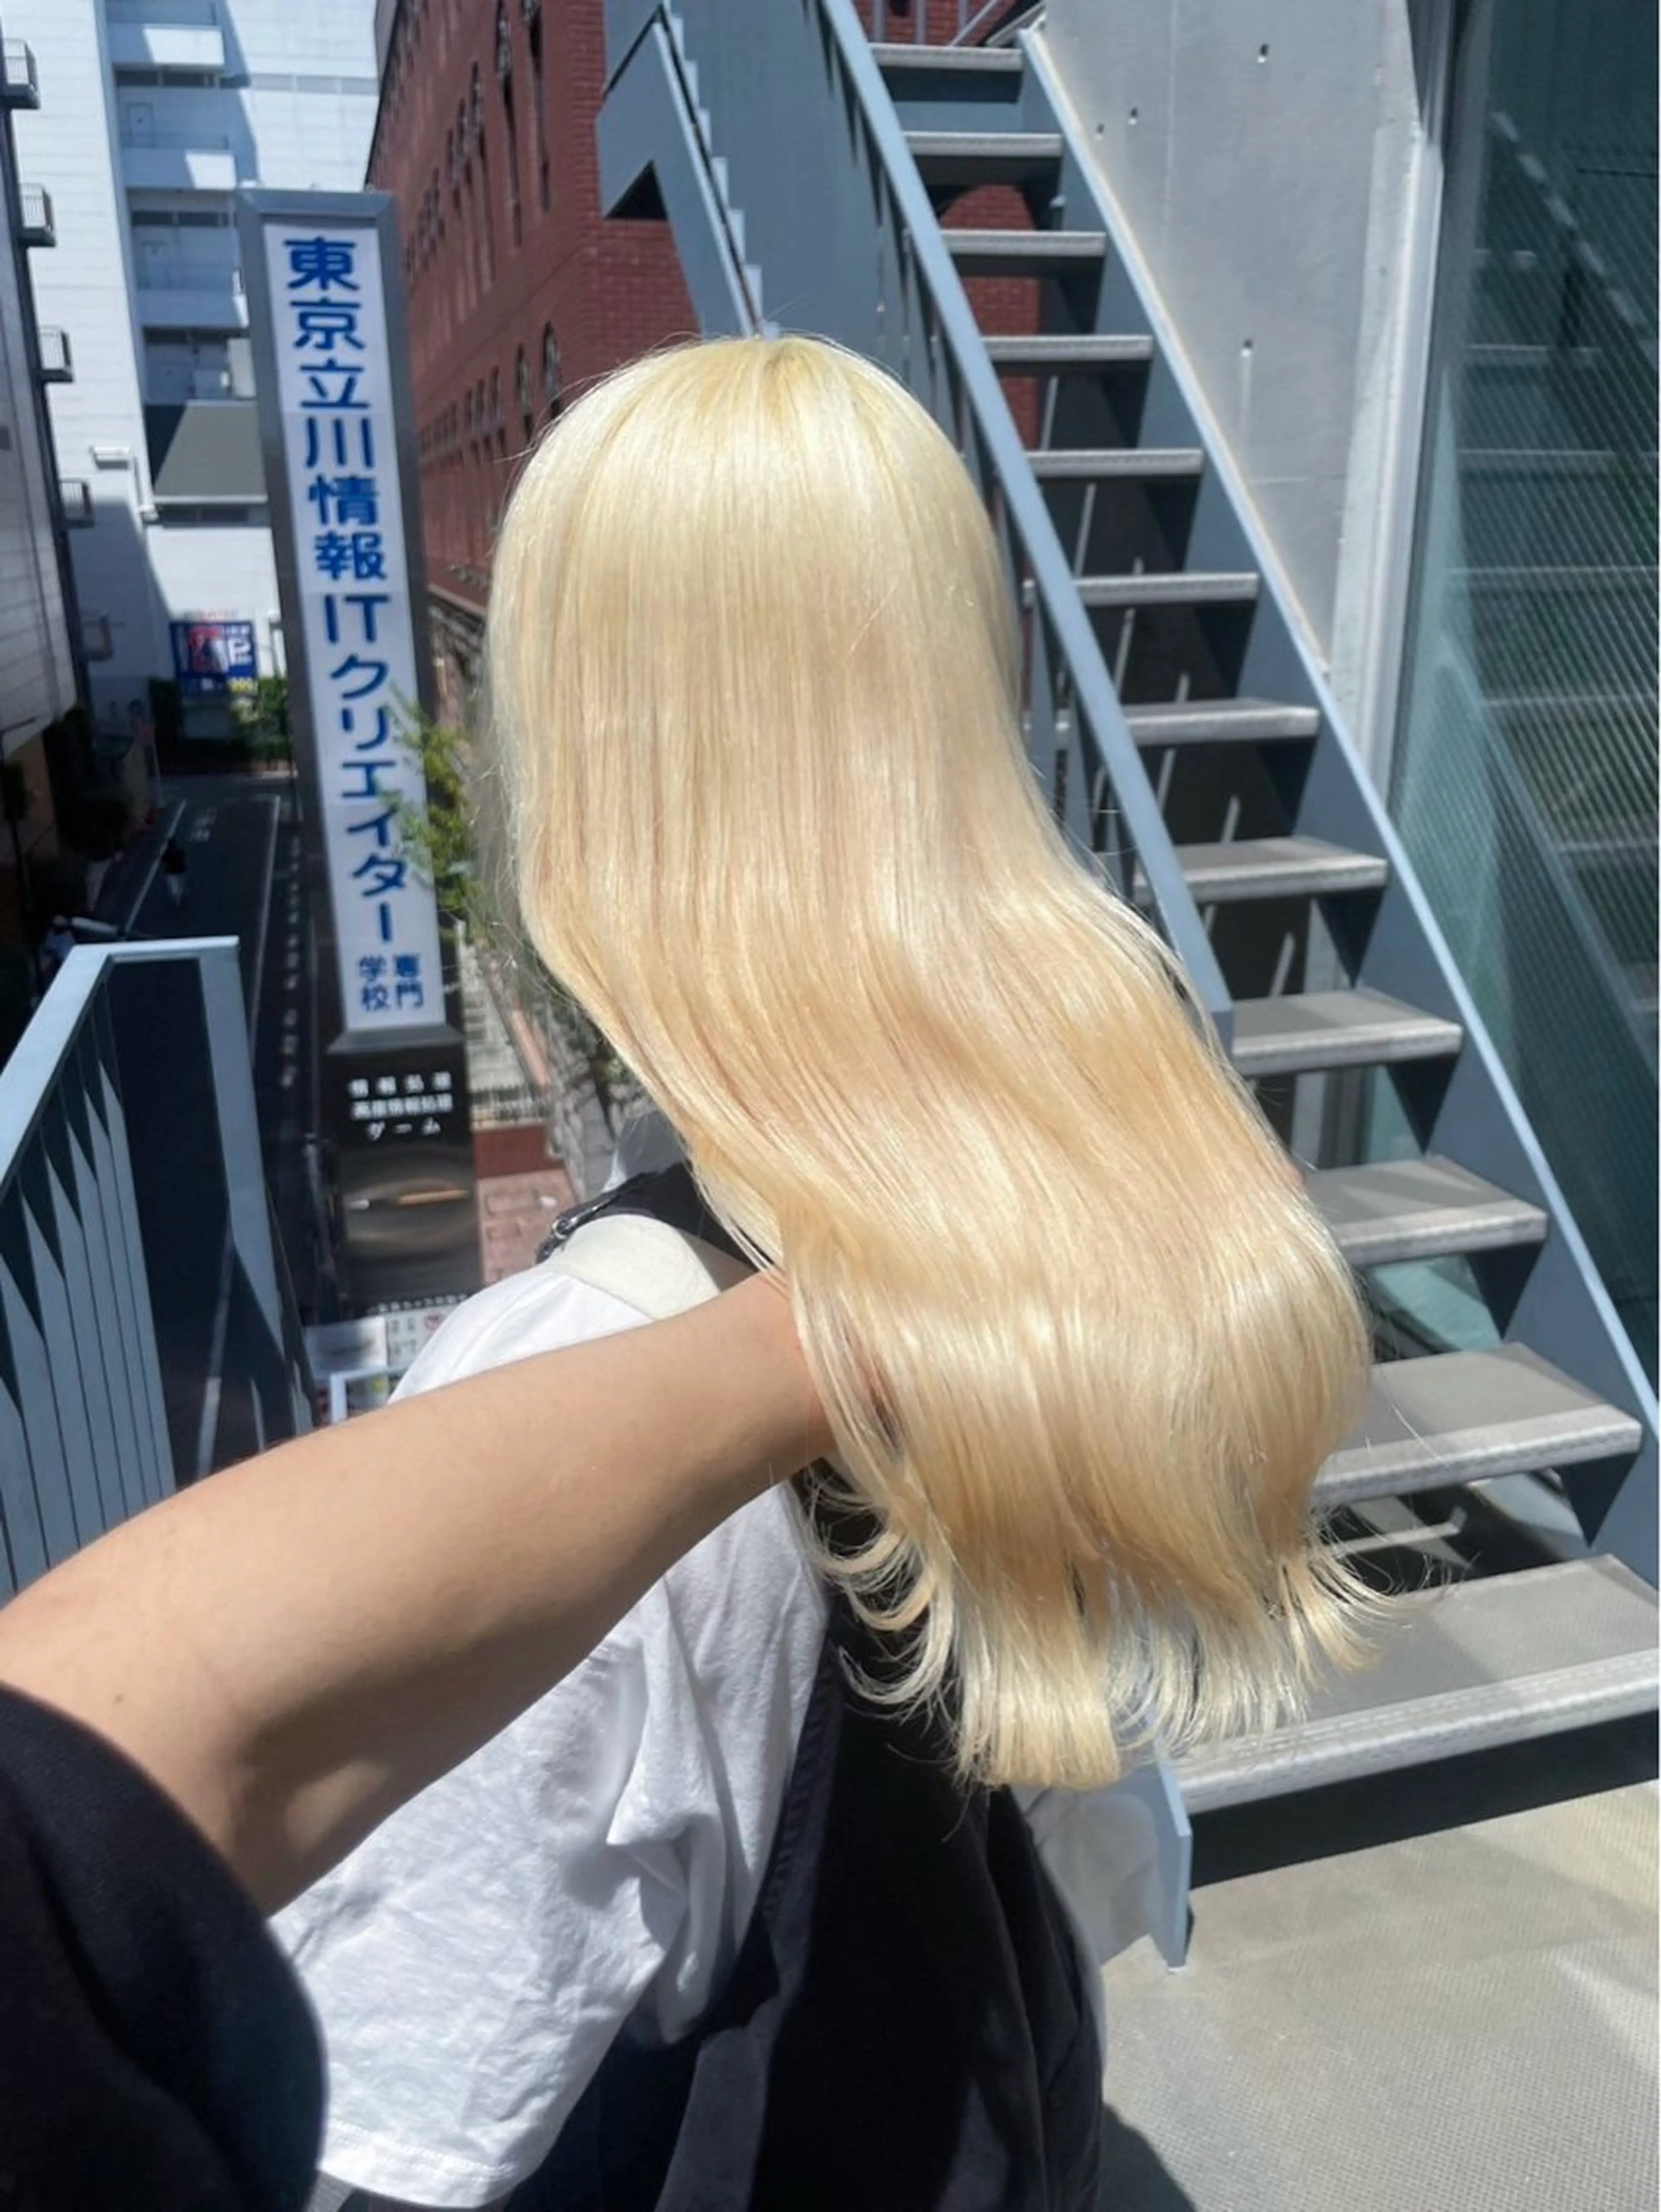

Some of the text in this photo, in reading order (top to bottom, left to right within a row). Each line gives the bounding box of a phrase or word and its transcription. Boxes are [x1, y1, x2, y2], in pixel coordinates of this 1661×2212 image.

[284, 236, 407, 942] 東京立川情報ITクリエイター
